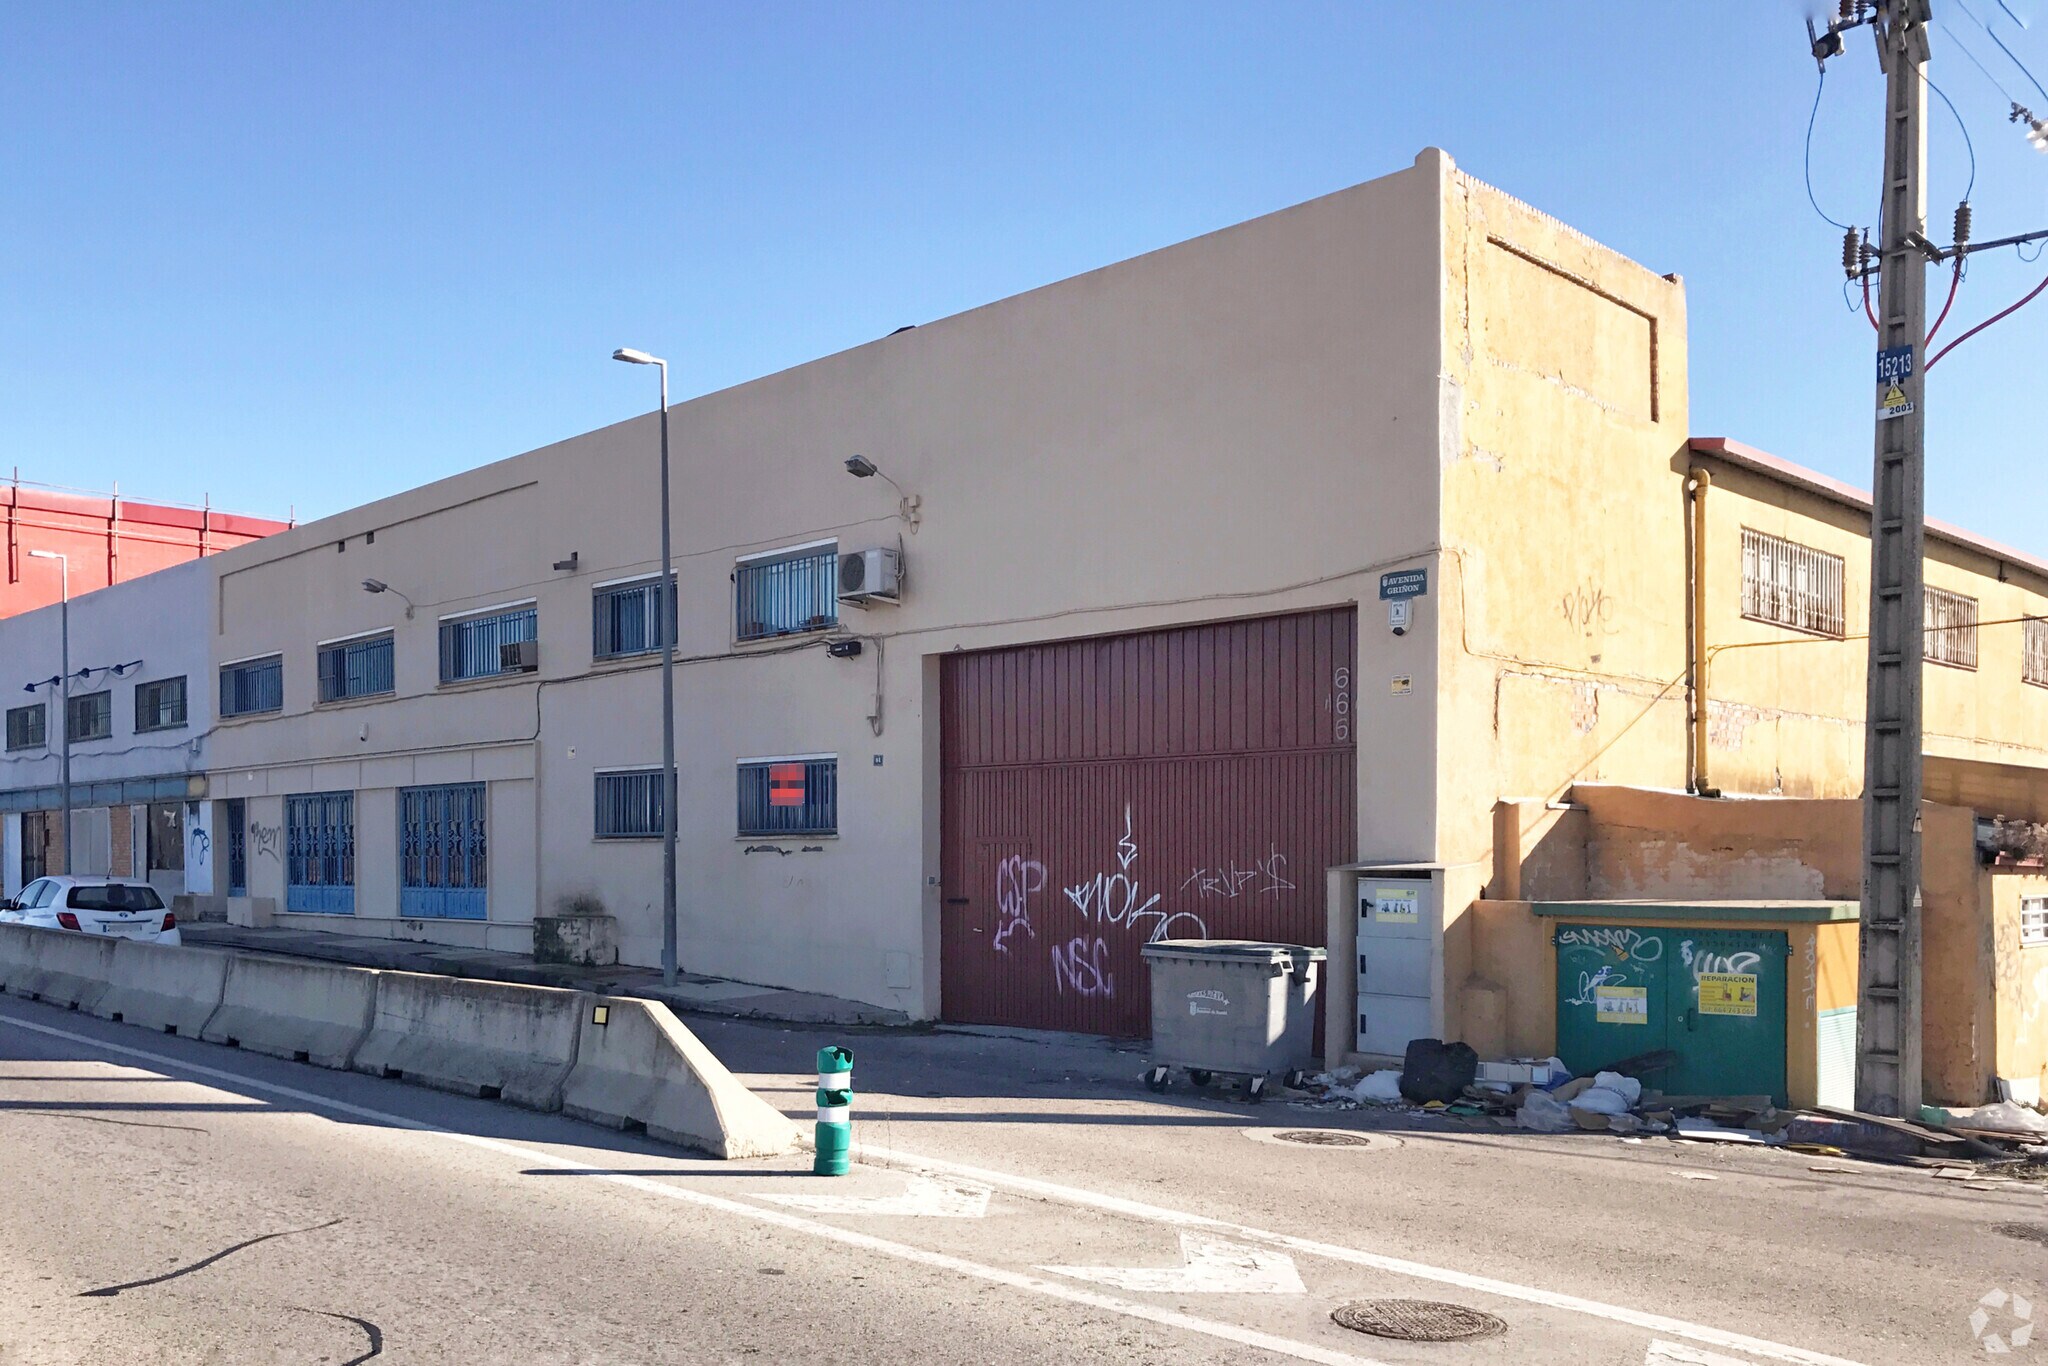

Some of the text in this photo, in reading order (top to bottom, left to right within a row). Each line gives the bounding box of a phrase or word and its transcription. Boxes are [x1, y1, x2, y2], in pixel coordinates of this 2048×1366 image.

[1878, 353, 1912, 378] 15213
[1889, 402, 1912, 415] 2001
[1388, 573, 1425, 586] AVENIDA
[1387, 584, 1419, 595] GRIÑON
[1334, 666, 1350, 740] 666
[1701, 975, 1755, 984] REPARACION
